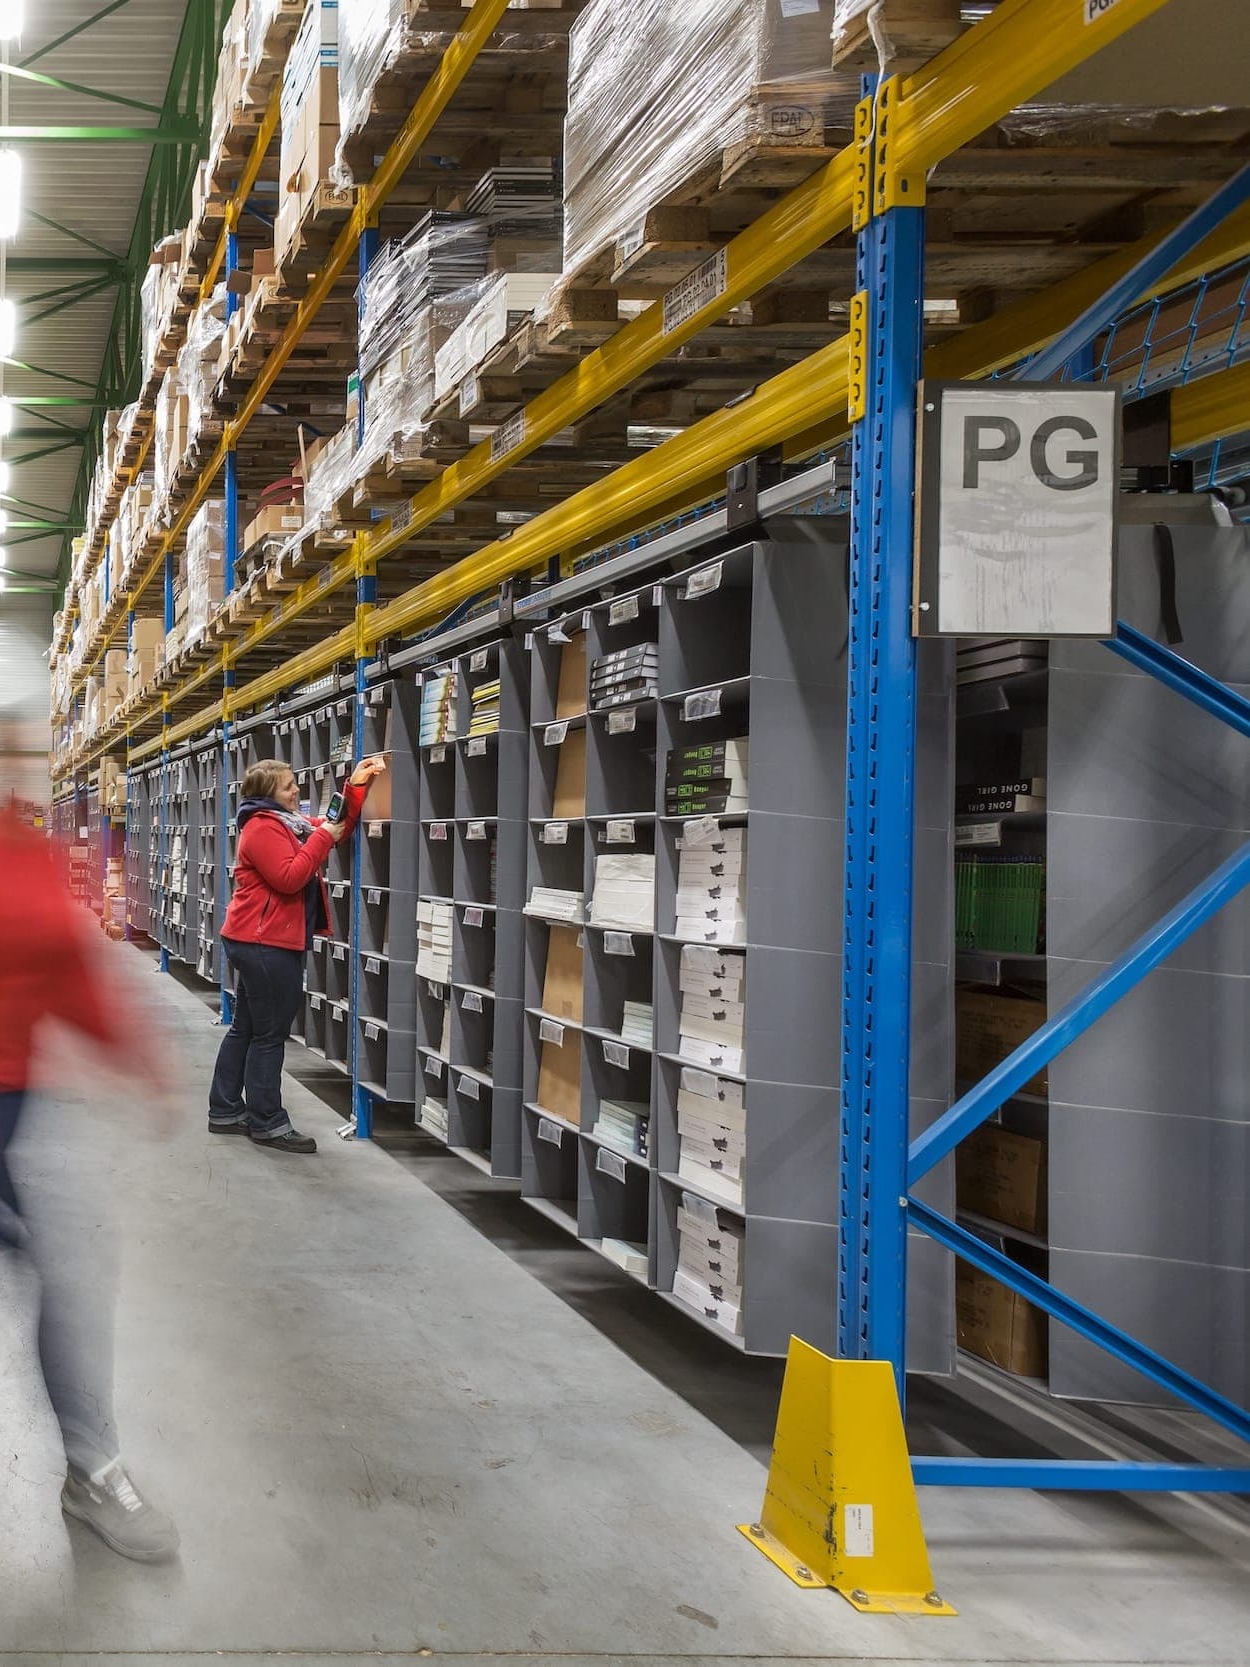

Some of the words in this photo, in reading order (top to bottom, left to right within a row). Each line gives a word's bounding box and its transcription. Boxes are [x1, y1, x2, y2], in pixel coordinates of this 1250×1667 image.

[771, 111, 806, 131] EPAL
[963, 415, 1099, 490] PG
[977, 785, 998, 795] GIRL
[1000, 783, 1028, 794] GONE
[988, 800, 1012, 810] GONE
